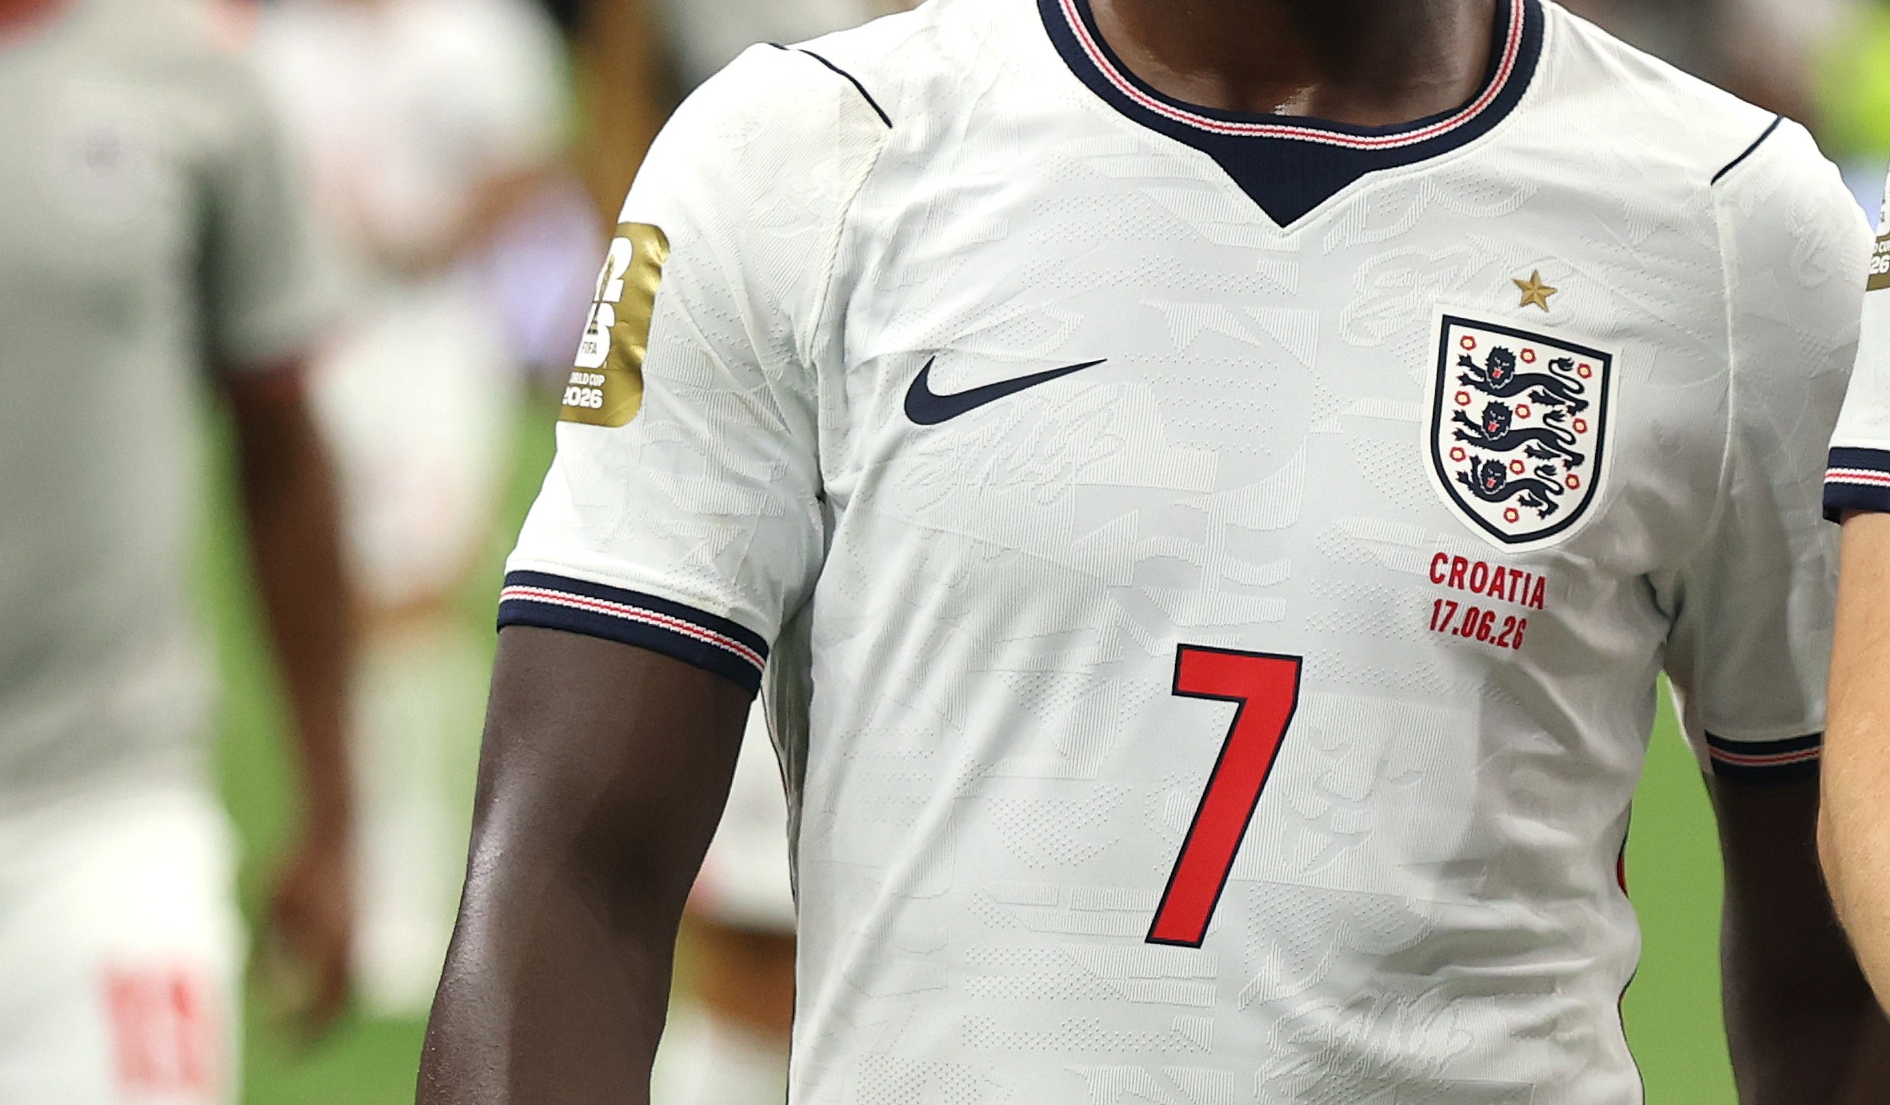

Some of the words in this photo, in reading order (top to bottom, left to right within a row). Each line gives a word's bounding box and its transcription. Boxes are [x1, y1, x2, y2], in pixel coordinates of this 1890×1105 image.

[1869, 254, 1890, 274] 26
[589, 373, 606, 387] CUP
[1429, 551, 1547, 611] CROATIA
[1429, 598, 1528, 651] 17.06.26
[1144, 643, 1303, 949] 7
